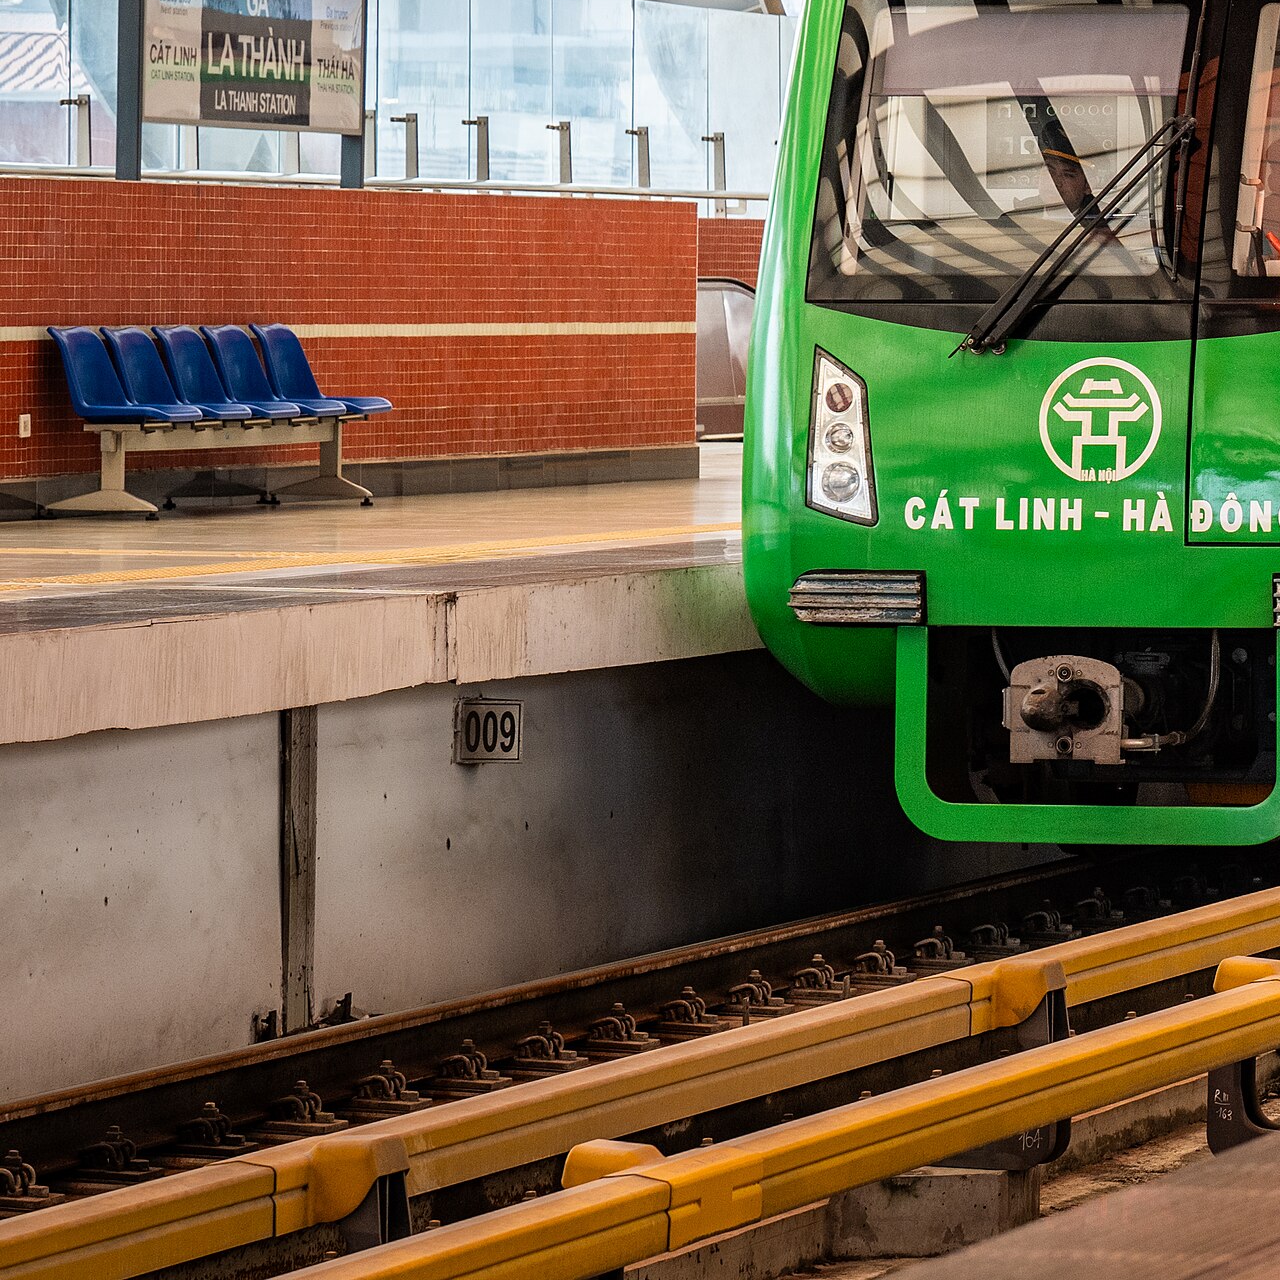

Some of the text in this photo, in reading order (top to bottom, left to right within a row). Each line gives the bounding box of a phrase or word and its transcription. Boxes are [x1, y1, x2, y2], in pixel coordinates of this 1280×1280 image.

[149, 39, 197, 67] CÁT LINH
[207, 26, 306, 82] LA THÀNH
[317, 55, 355, 81] THÁI HÀ
[215, 89, 296, 115] LA THANH STATION
[1081, 467, 1116, 484] HÀ NỘI
[904, 489, 981, 530] CÁT
[994, 497, 1082, 531] LINH
[1122, 491, 1173, 532] HÀ
[465, 710, 516, 753] 009
[1018, 1128, 1043, 1151] 164
